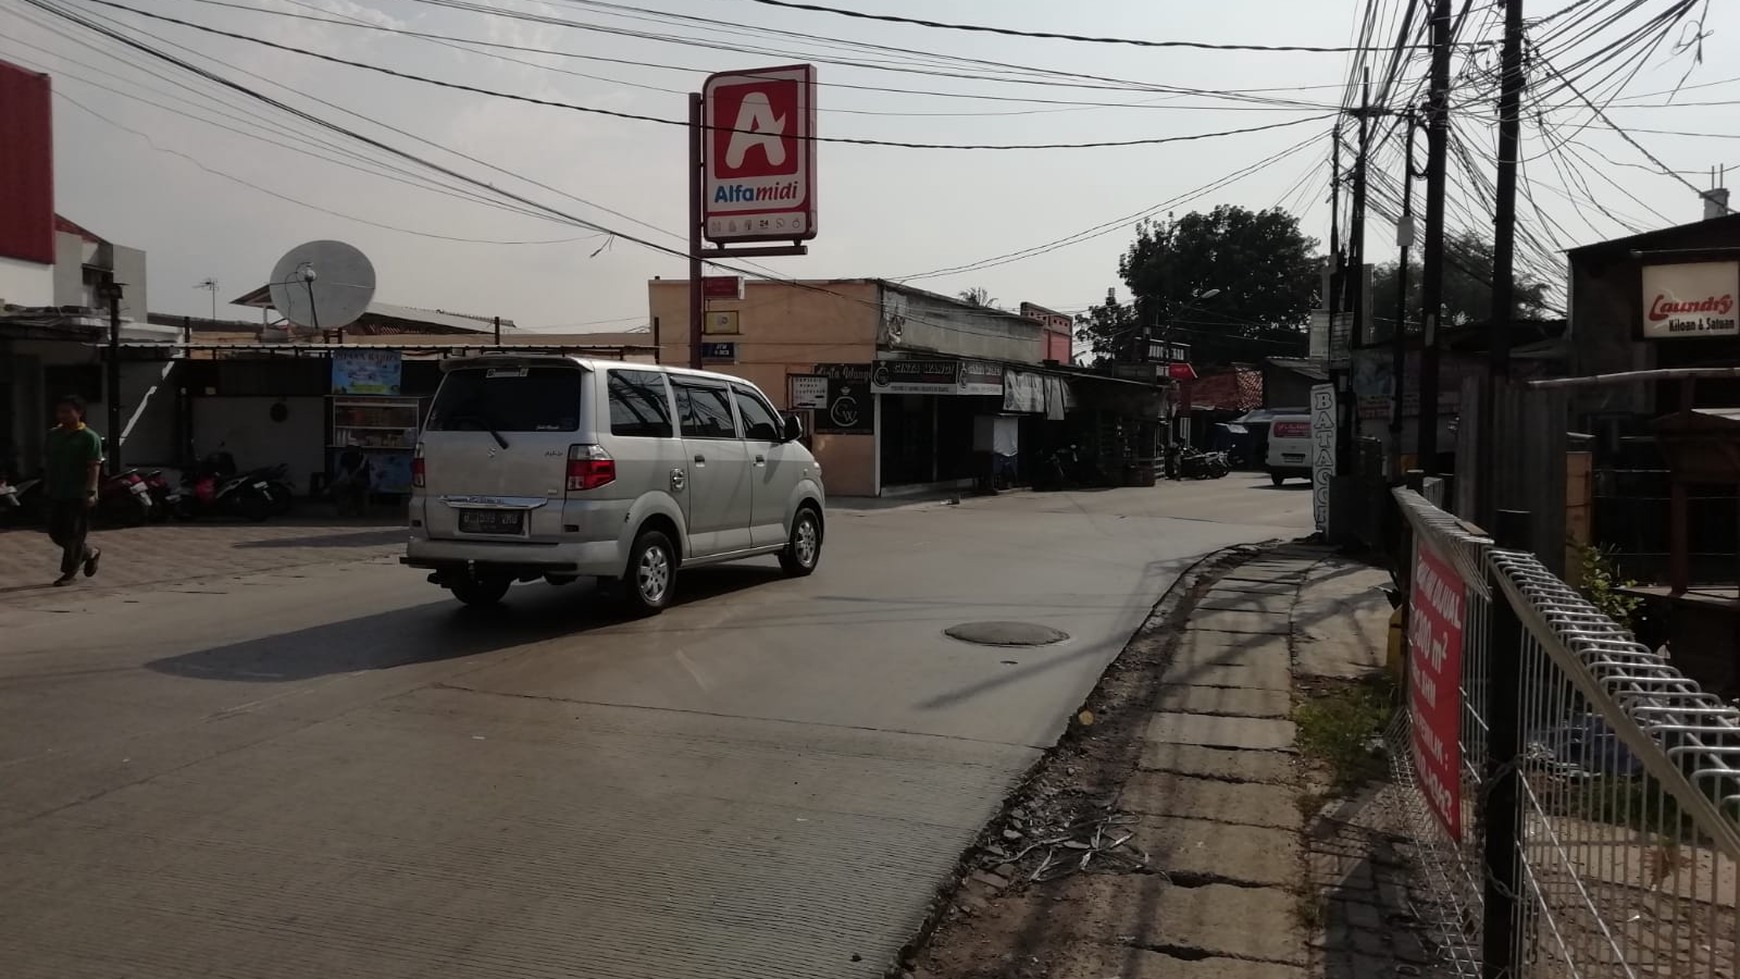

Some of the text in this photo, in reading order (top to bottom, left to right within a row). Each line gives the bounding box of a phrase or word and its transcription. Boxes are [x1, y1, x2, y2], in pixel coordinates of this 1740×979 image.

[714, 181, 798, 203] Alfamidi
[1649, 294, 1733, 322] Laundry
[1669, 318, 1696, 332] Kiloan
[1706, 317, 1735, 330] Satuan
